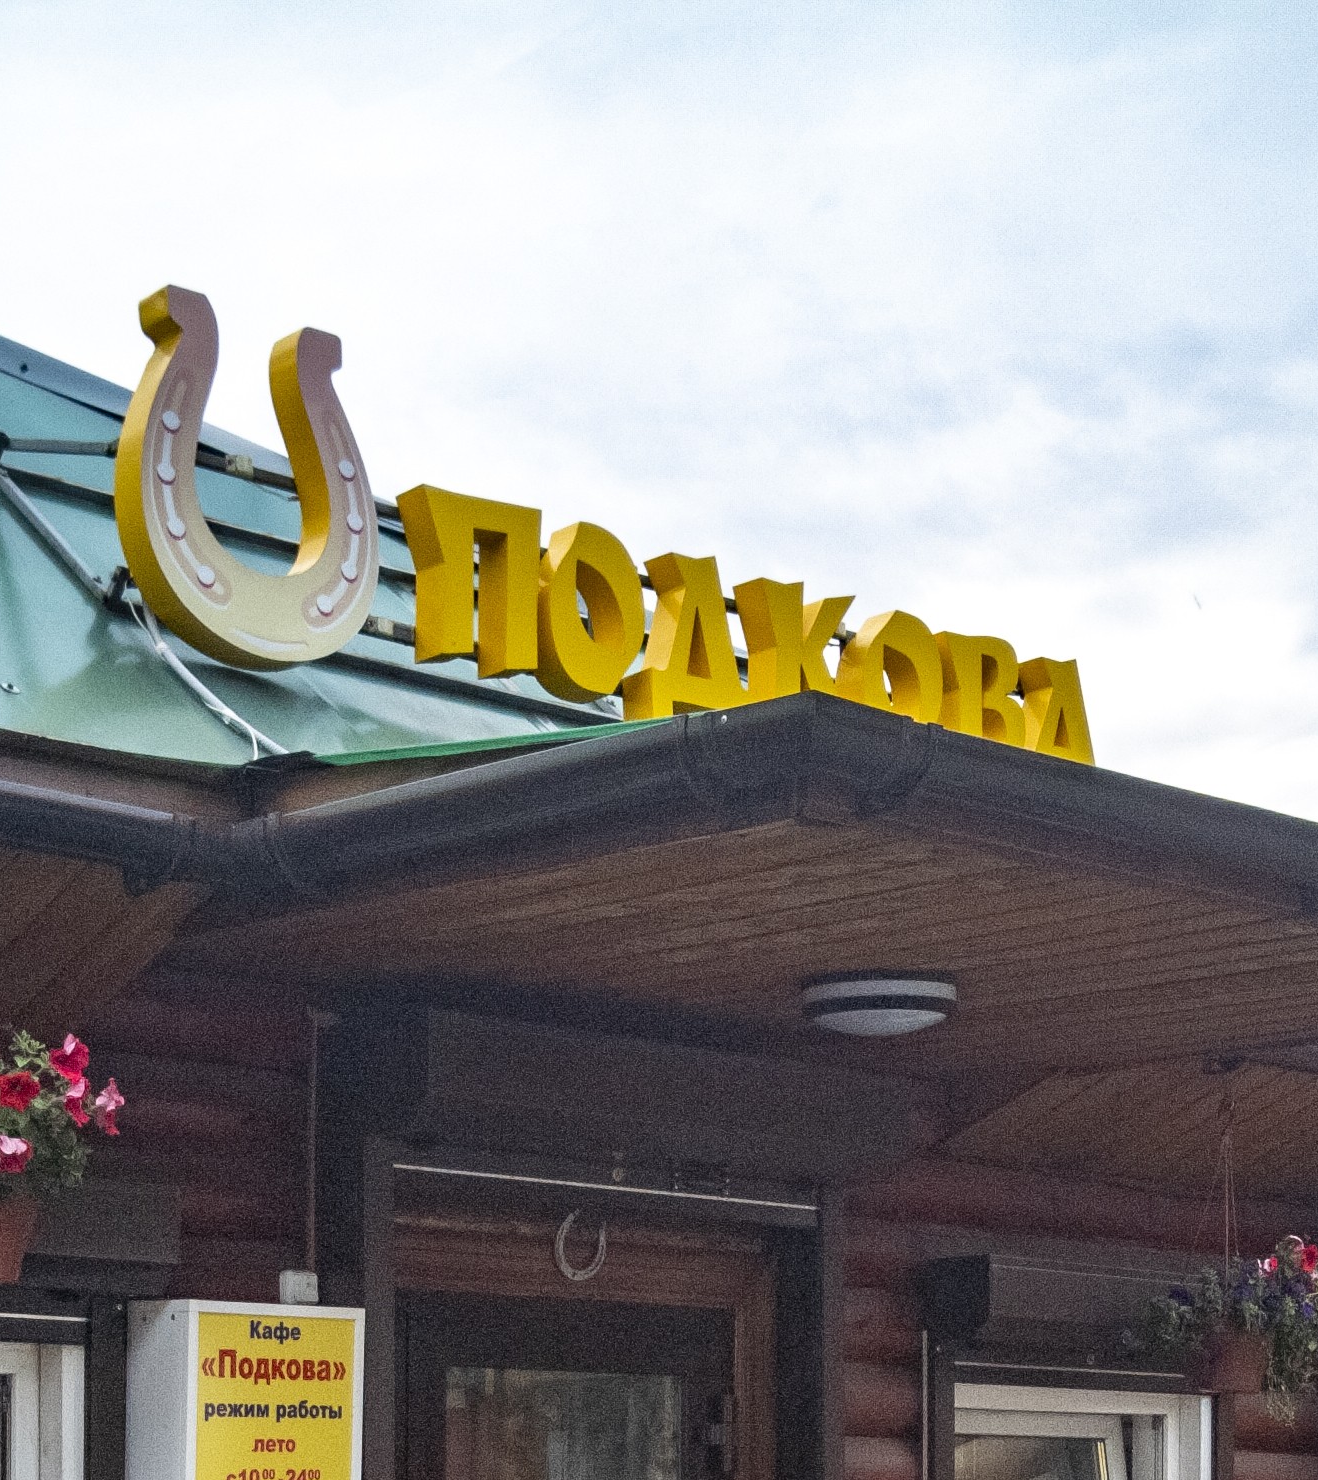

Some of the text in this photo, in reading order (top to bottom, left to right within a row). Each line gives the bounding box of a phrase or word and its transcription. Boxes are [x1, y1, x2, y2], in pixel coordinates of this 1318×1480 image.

[395, 483, 1095, 767] ПОДКОВА
[249, 1319, 302, 1344] Кафе
[201, 1348, 347, 1385] «Подкова»
[204, 1399, 343, 1422] режим работы
[251, 1438, 296, 1453] лето
